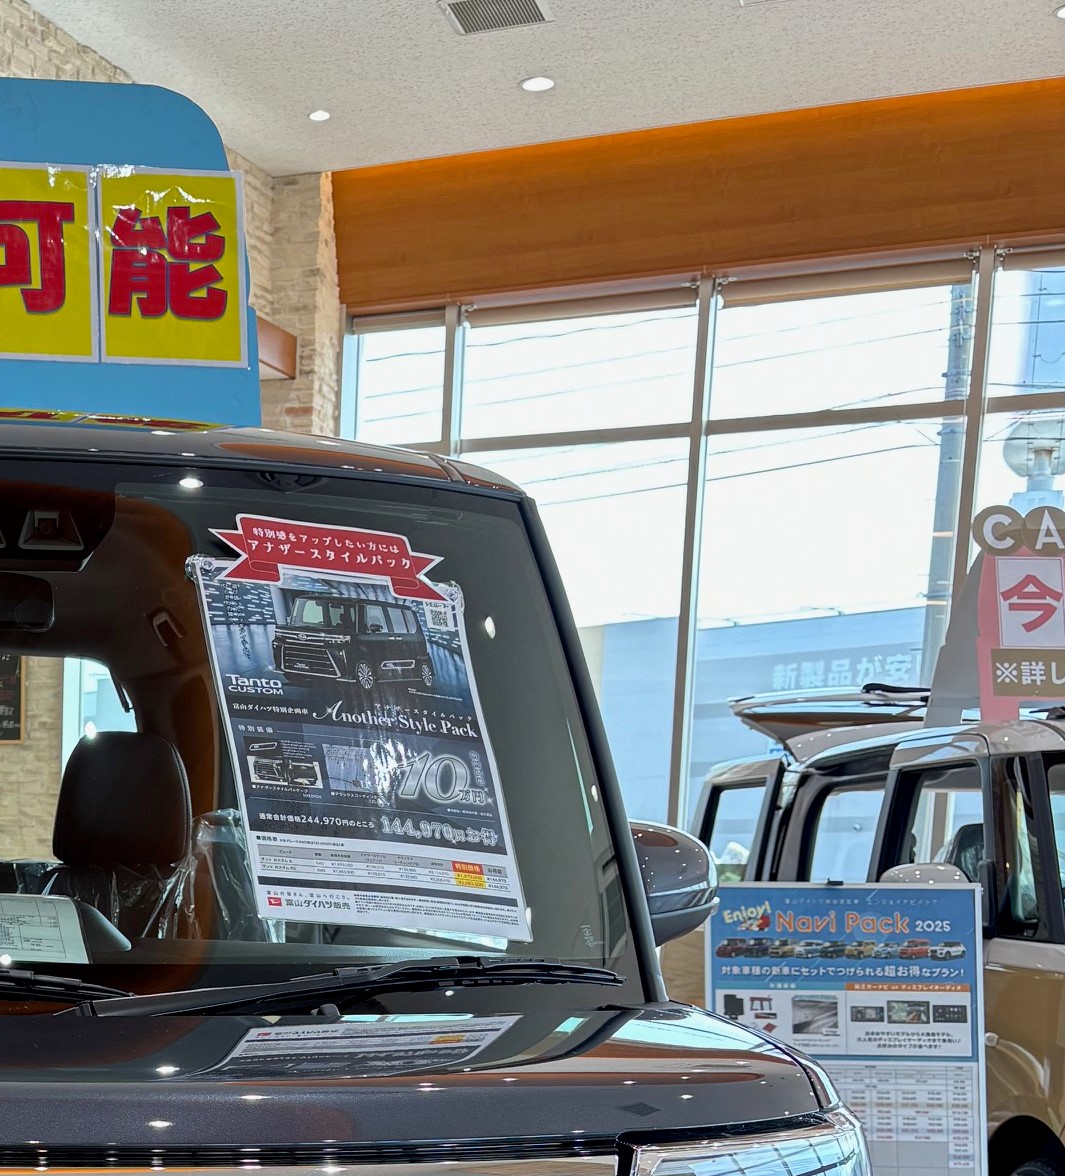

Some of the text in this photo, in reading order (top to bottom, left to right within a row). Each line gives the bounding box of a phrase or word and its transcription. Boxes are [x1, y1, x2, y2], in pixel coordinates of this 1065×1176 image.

[252, 527, 400, 554] 特別感をアップしたい方には
[246, 539, 412, 569] アナザースタイルパック
[1000, 574, 1063, 633] 今
[225, 673, 282, 688] Tanto
[228, 685, 284, 696] CUSTOM
[312, 700, 478, 738] Another Style Pack
[285, 898, 351, 910] 富山ダイハツ販売
[723, 901, 772, 924] Enjoy!
[776, 911, 951, 934] Navi Pack 2025
